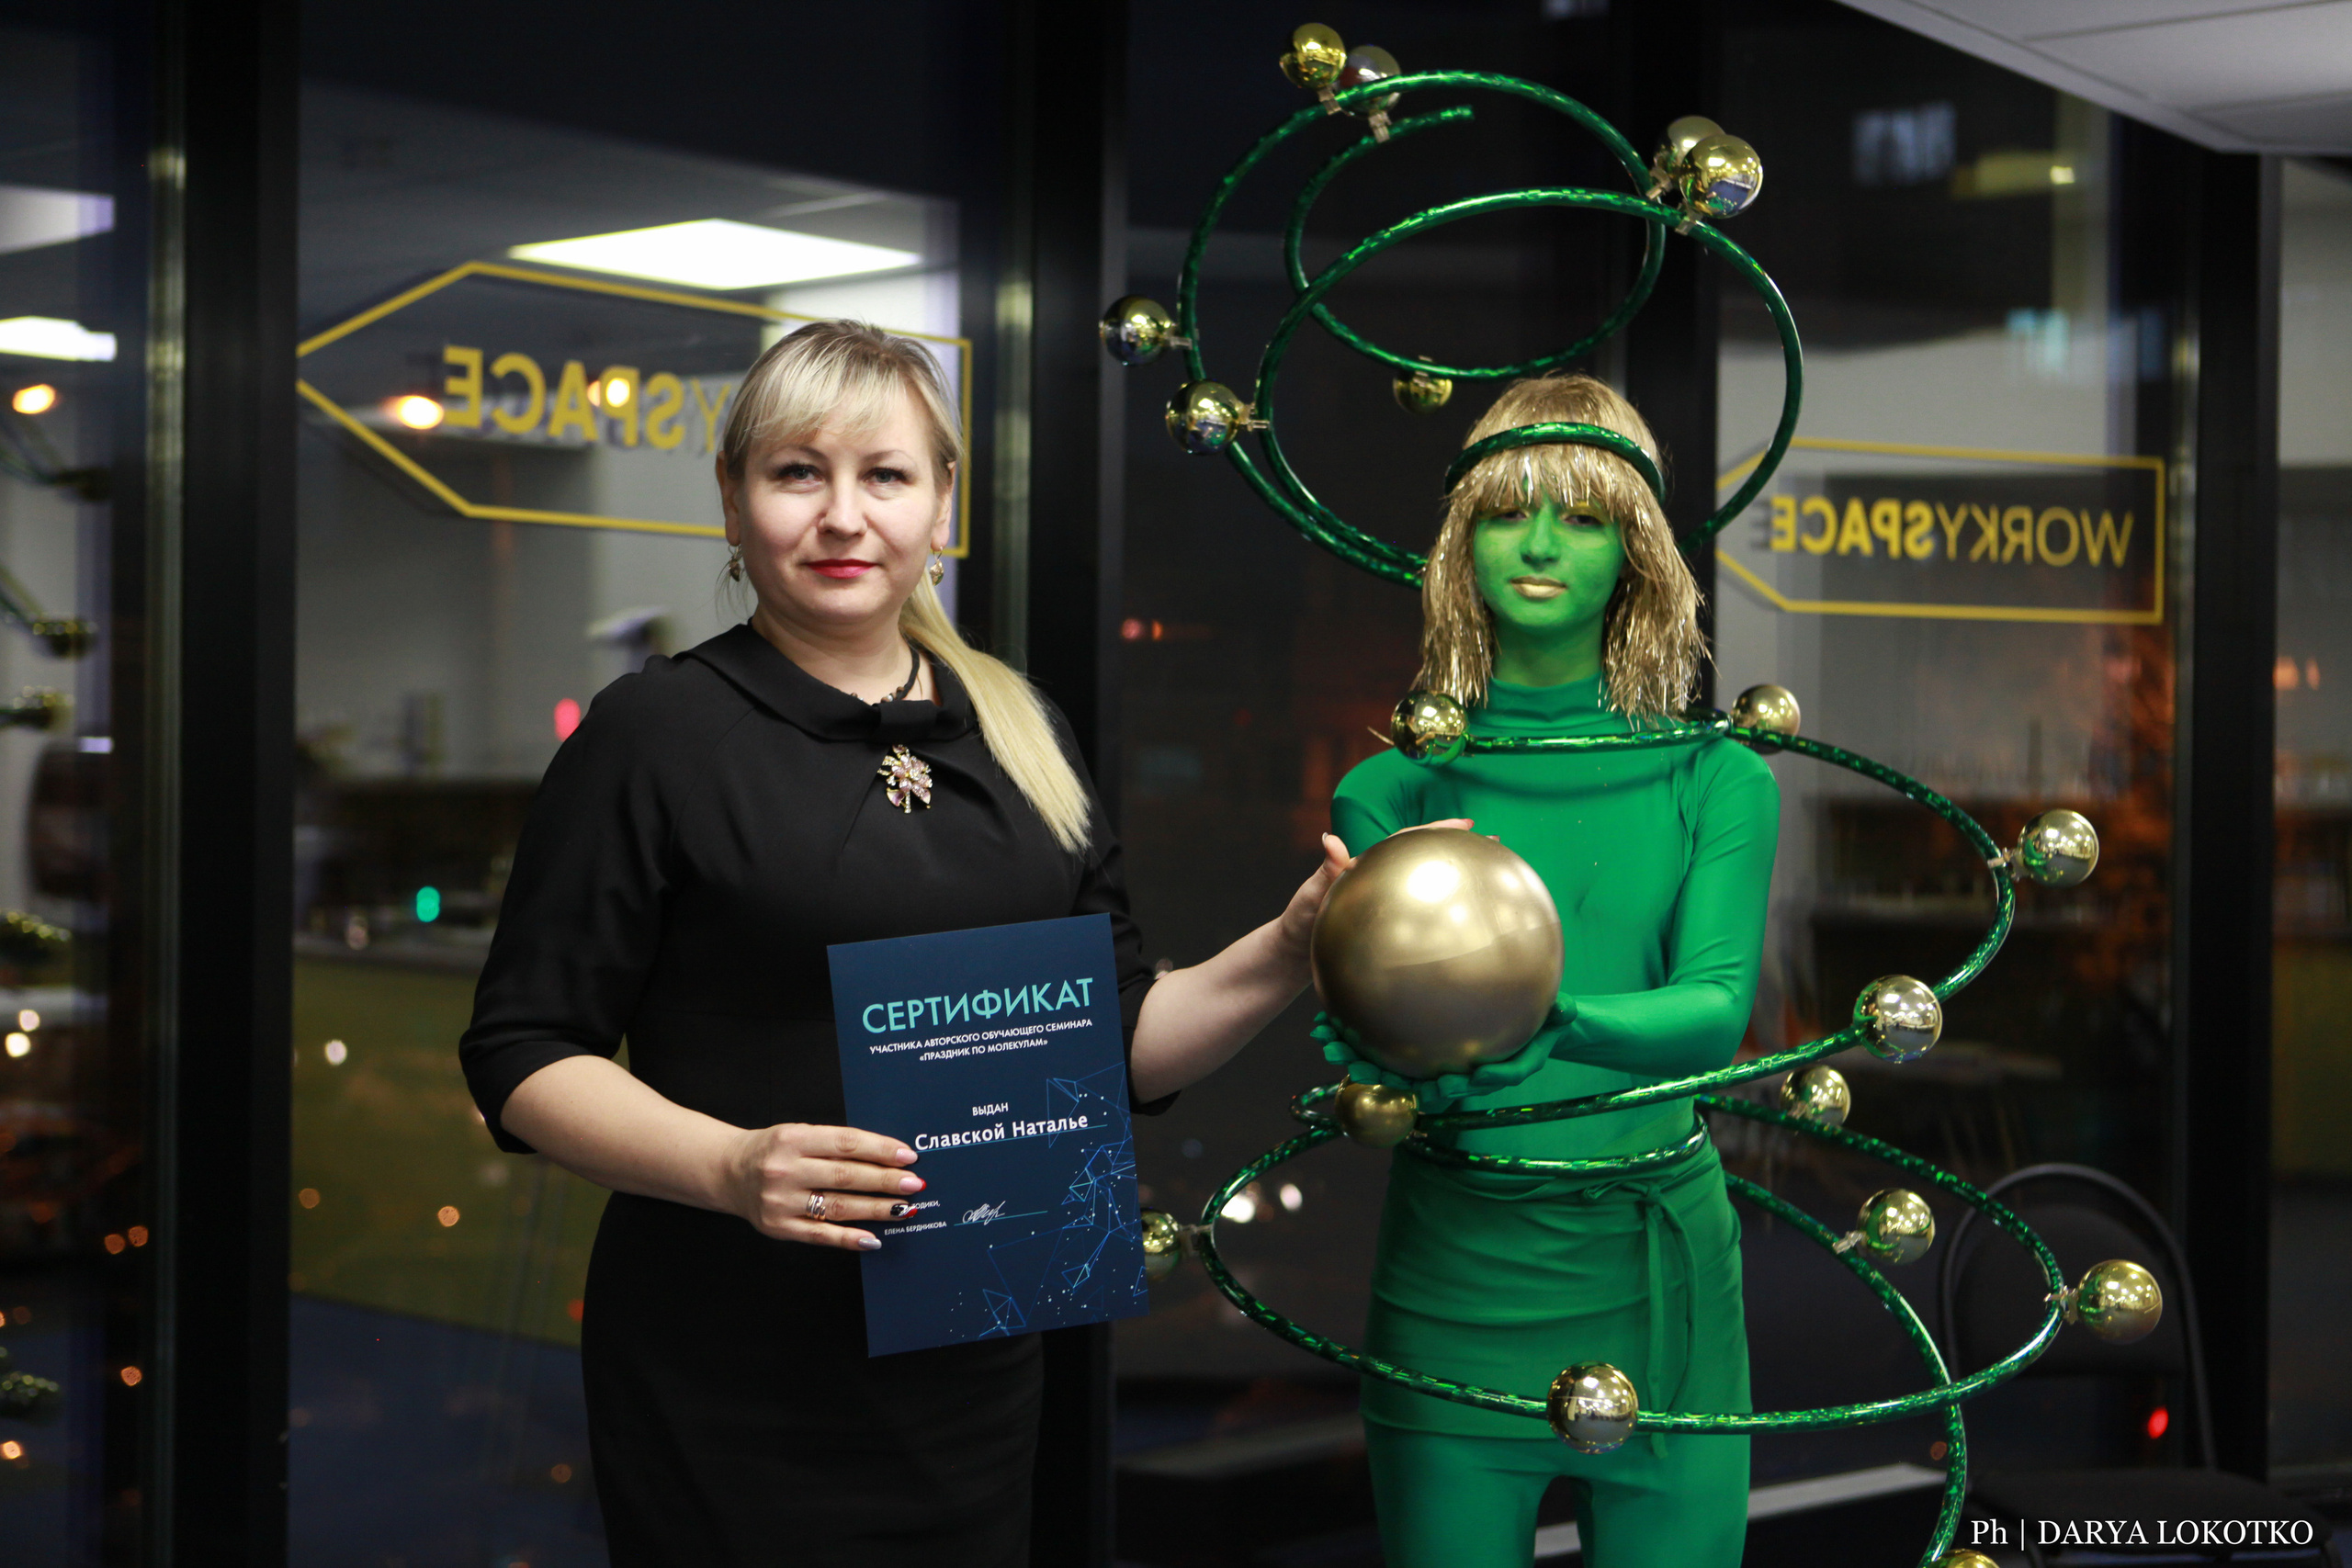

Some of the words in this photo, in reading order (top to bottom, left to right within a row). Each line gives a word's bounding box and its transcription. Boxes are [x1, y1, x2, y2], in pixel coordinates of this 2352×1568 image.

[862, 977, 1093, 1033] СЕРТИФИКАТ
[869, 1040, 923, 1055] УЧАСТНИКА
[923, 1032, 980, 1049] АВТОРСКОГО
[981, 1024, 1045, 1042] ОБУЧАЮЩЕГО
[1045, 1018, 1093, 1033] СЕМИНАРА
[919, 1048, 971, 1063] «ПРАЗДНИК
[971, 1044, 987, 1055] ПО
[987, 1038, 1049, 1054] МОЛЕКУЛАМ»
[972, 1102, 1010, 1117] ВЫДАН
[914, 1122, 1006, 1151] Славской
[1012, 1114, 1089, 1138] Наталье
[906, 1221, 947, 1233] БЕРДНИКОВА
